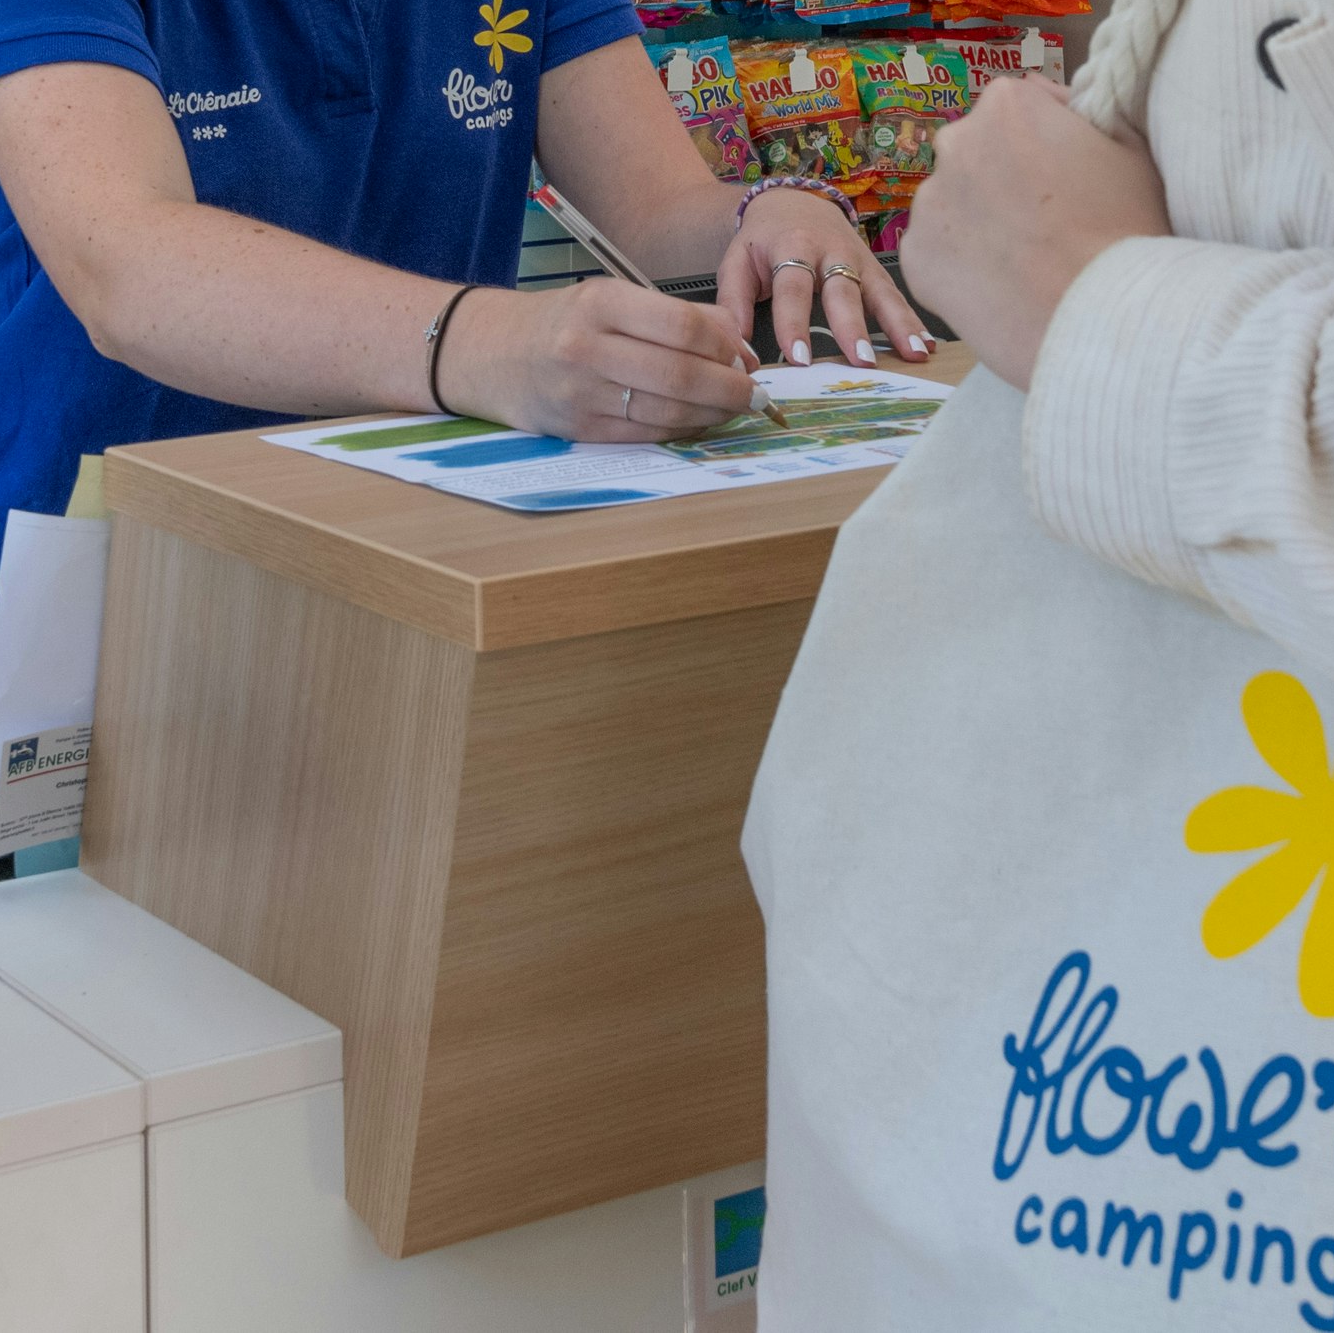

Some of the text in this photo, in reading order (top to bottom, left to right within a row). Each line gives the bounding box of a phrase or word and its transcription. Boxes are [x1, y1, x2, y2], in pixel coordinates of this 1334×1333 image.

[959, 44, 1042, 72] HARIB
[186, 84, 262, 115] Chênaie
[773, 91, 843, 118] World Mix
[8, 760, 37, 778] AFB
[717, 1276, 744, 1297] Clef
